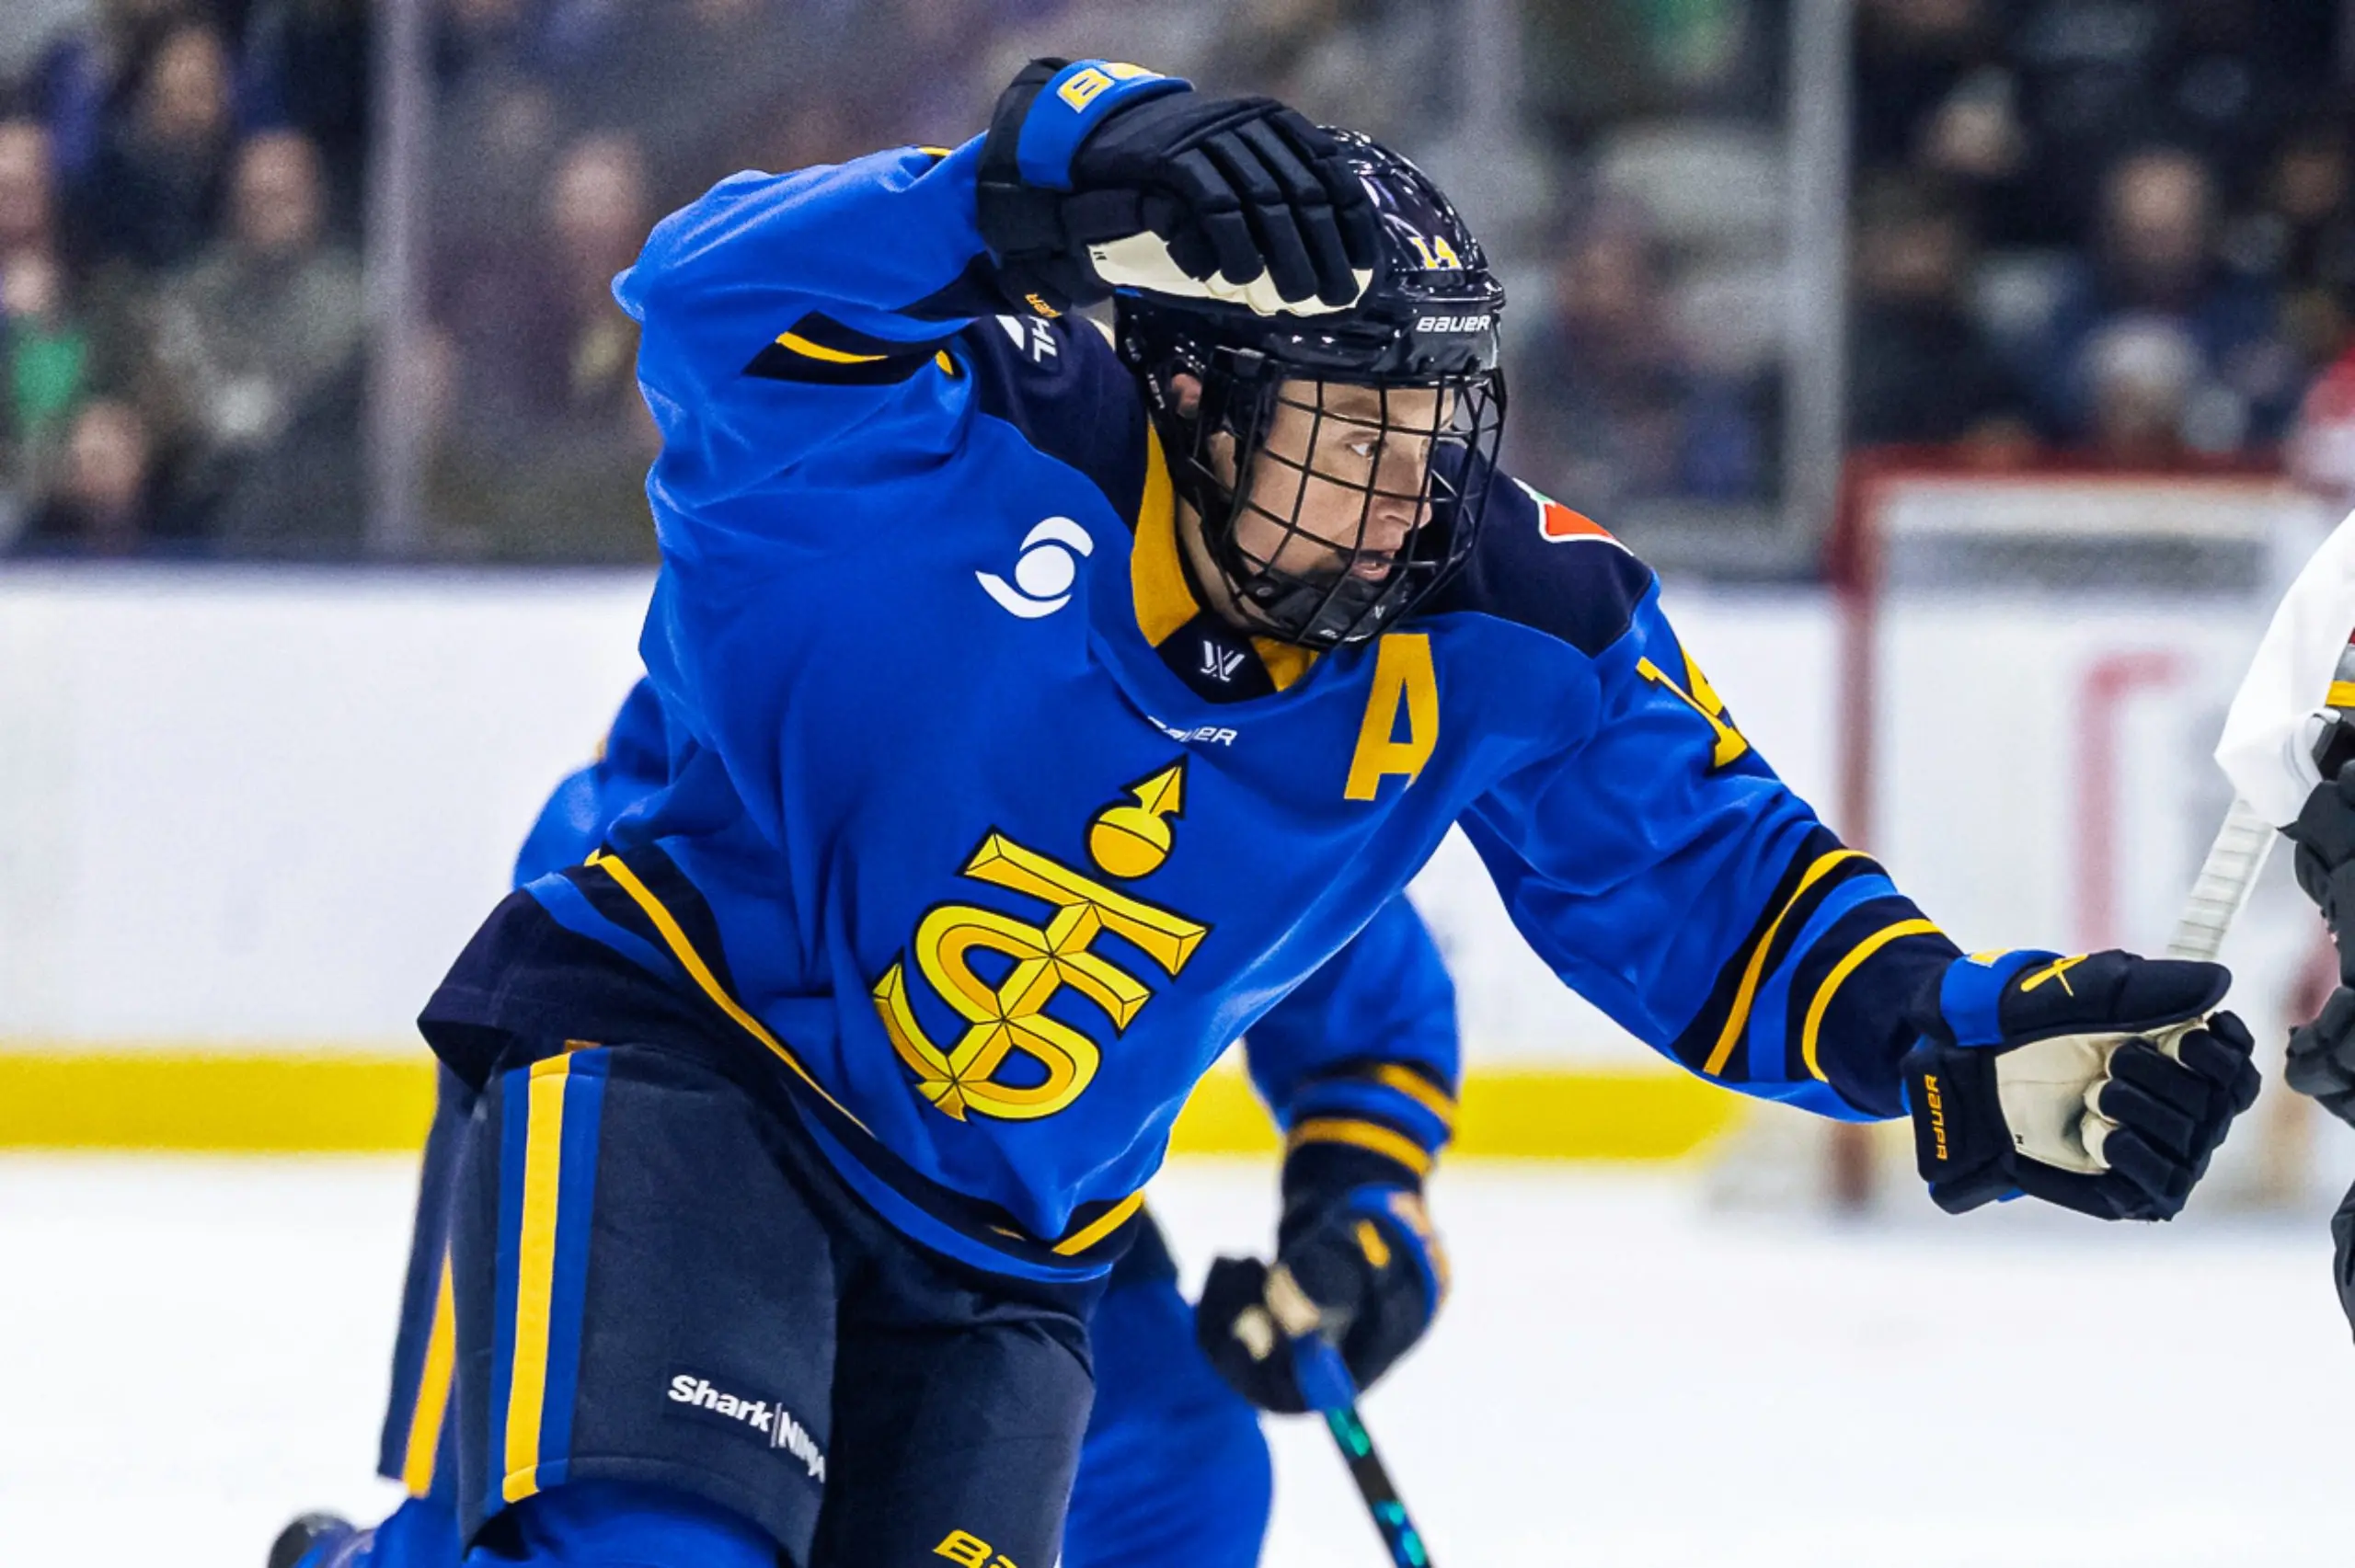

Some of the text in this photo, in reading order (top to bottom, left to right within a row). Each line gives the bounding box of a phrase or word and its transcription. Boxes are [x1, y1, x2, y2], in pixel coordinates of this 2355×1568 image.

[1407, 235, 1464, 269] 14
[1416, 315, 1492, 333] BAUER
[1343, 633, 1440, 801] A
[667, 1374, 775, 1433] Shark
